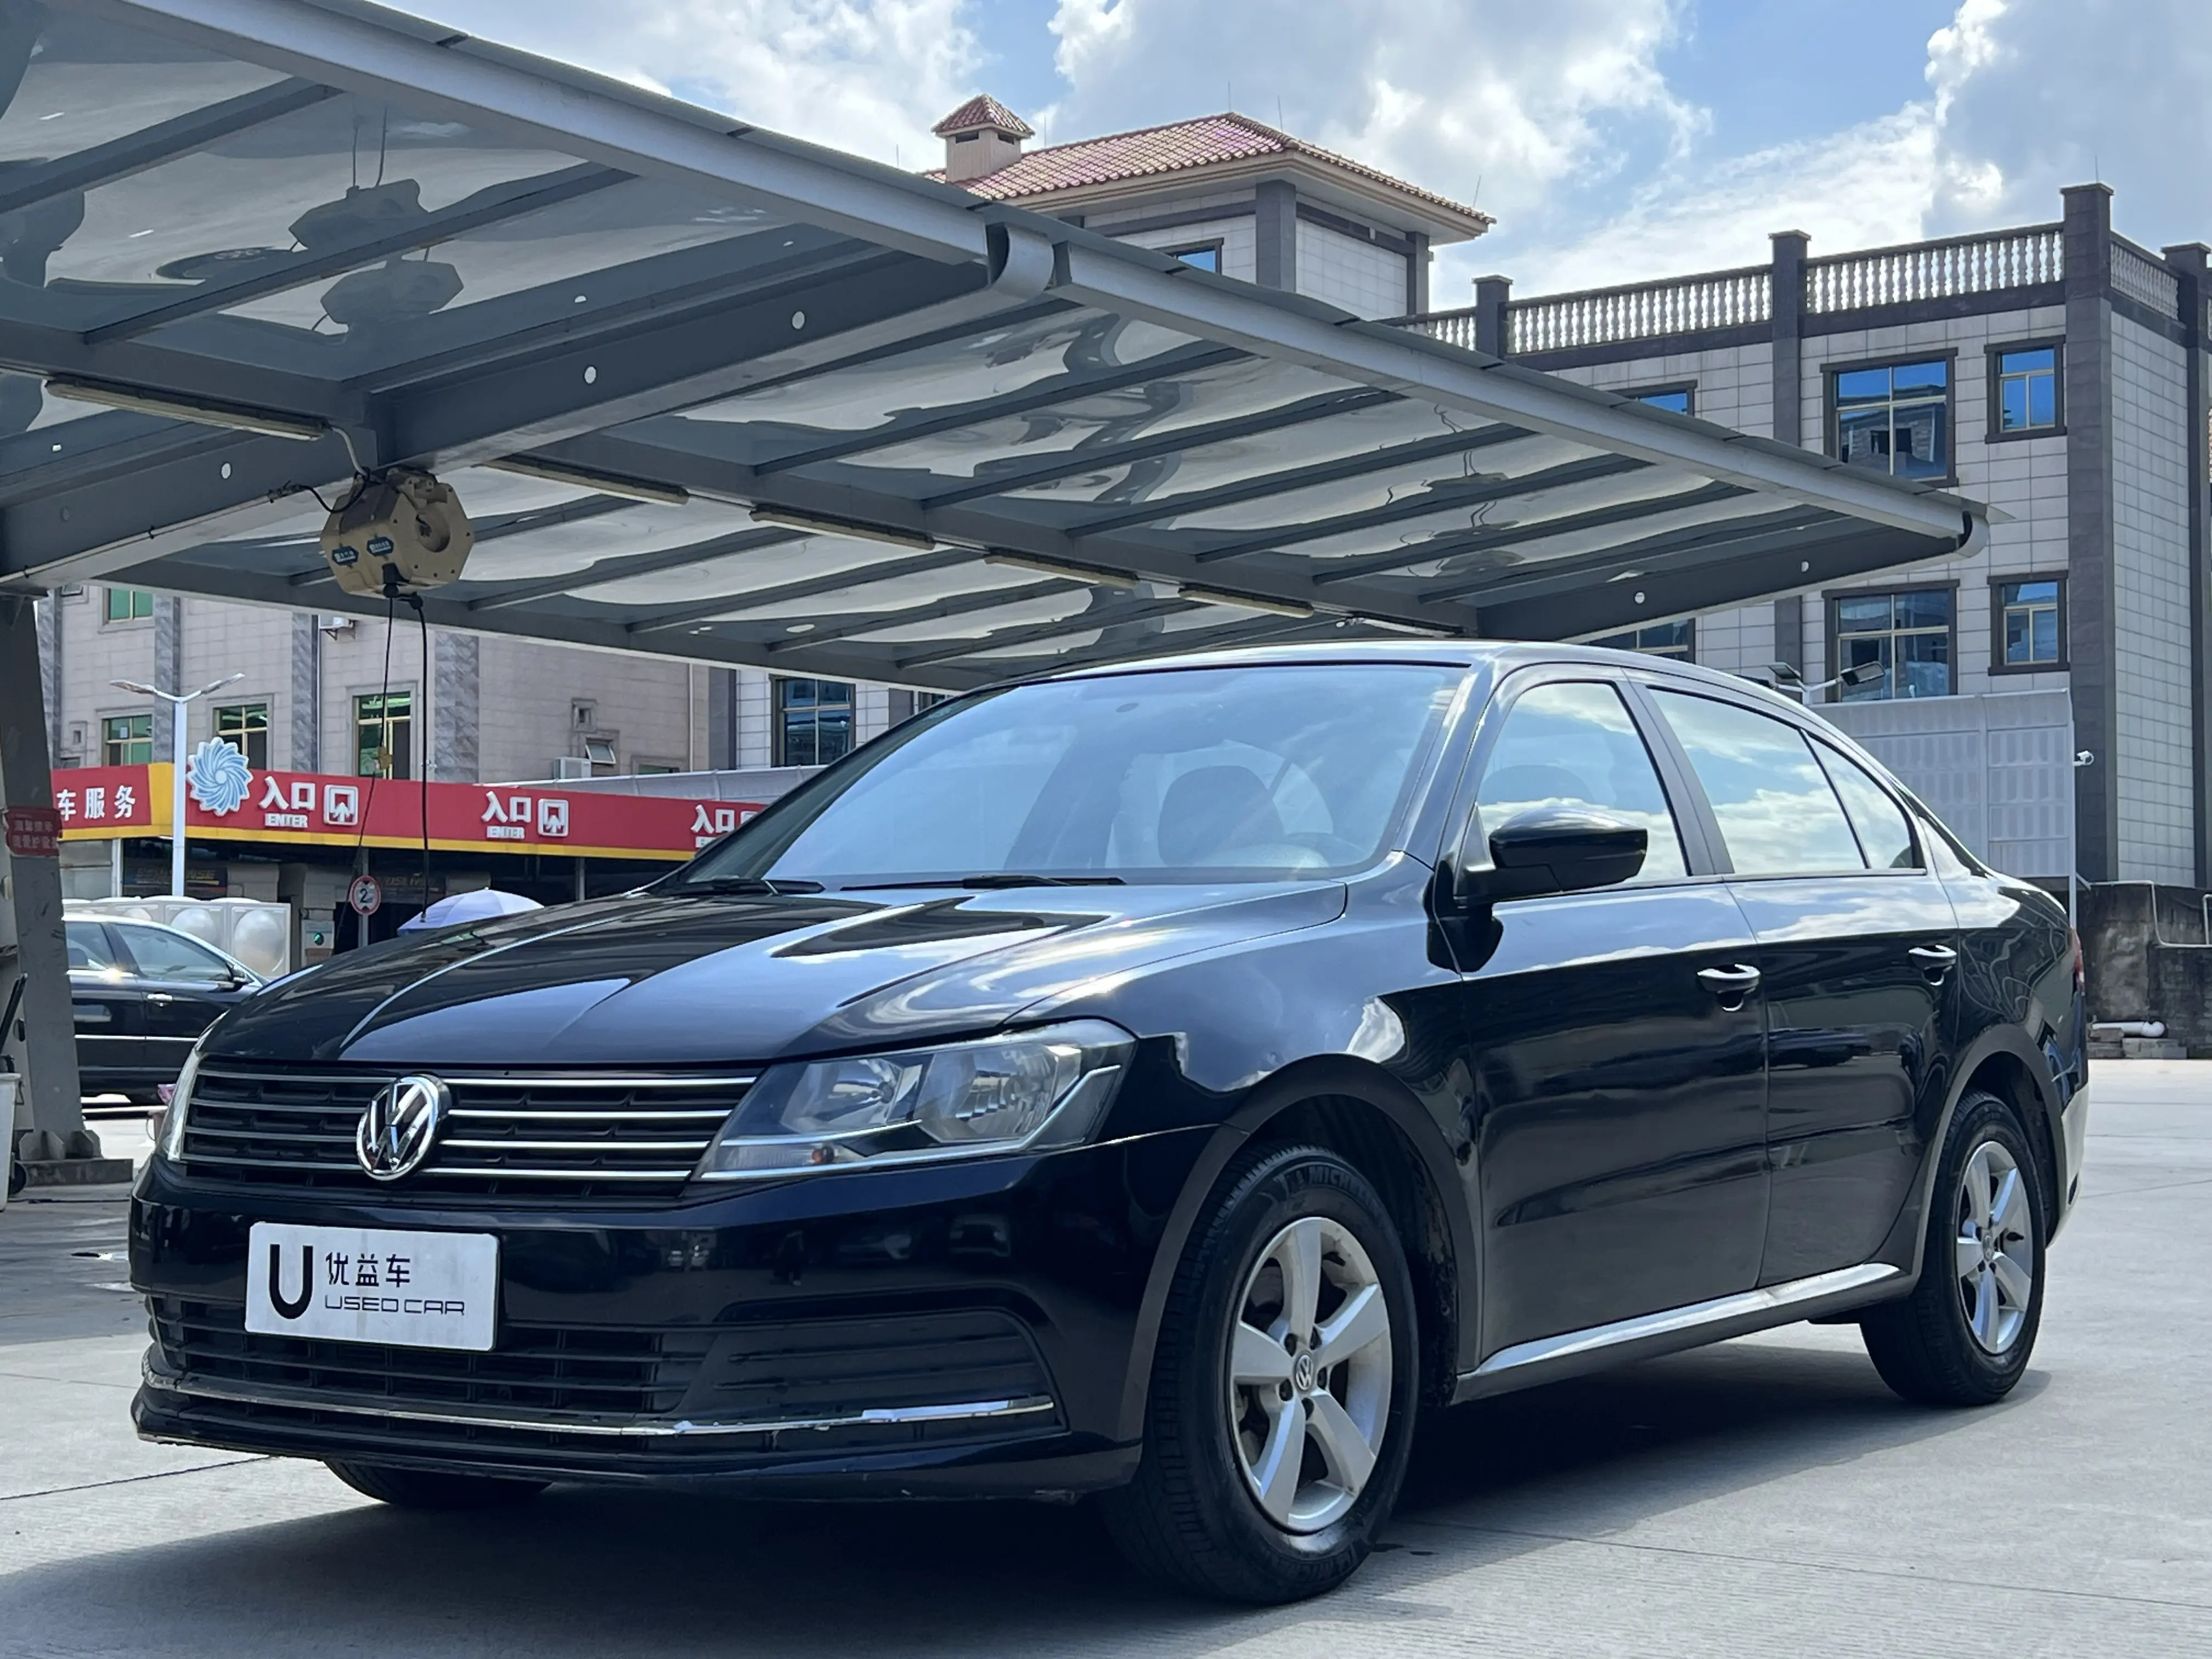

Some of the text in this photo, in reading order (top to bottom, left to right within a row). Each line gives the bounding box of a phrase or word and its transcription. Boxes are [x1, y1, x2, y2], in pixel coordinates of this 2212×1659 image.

[57, 785, 136, 821] 车服务
[258, 776, 315, 810] 入口
[481, 791, 532, 823] 入口
[264, 813, 308, 828] ENTER
[691, 804, 735, 834] 入口
[325, 1252, 411, 1288] 优益车
[325, 1295, 465, 1316] USED CAR
